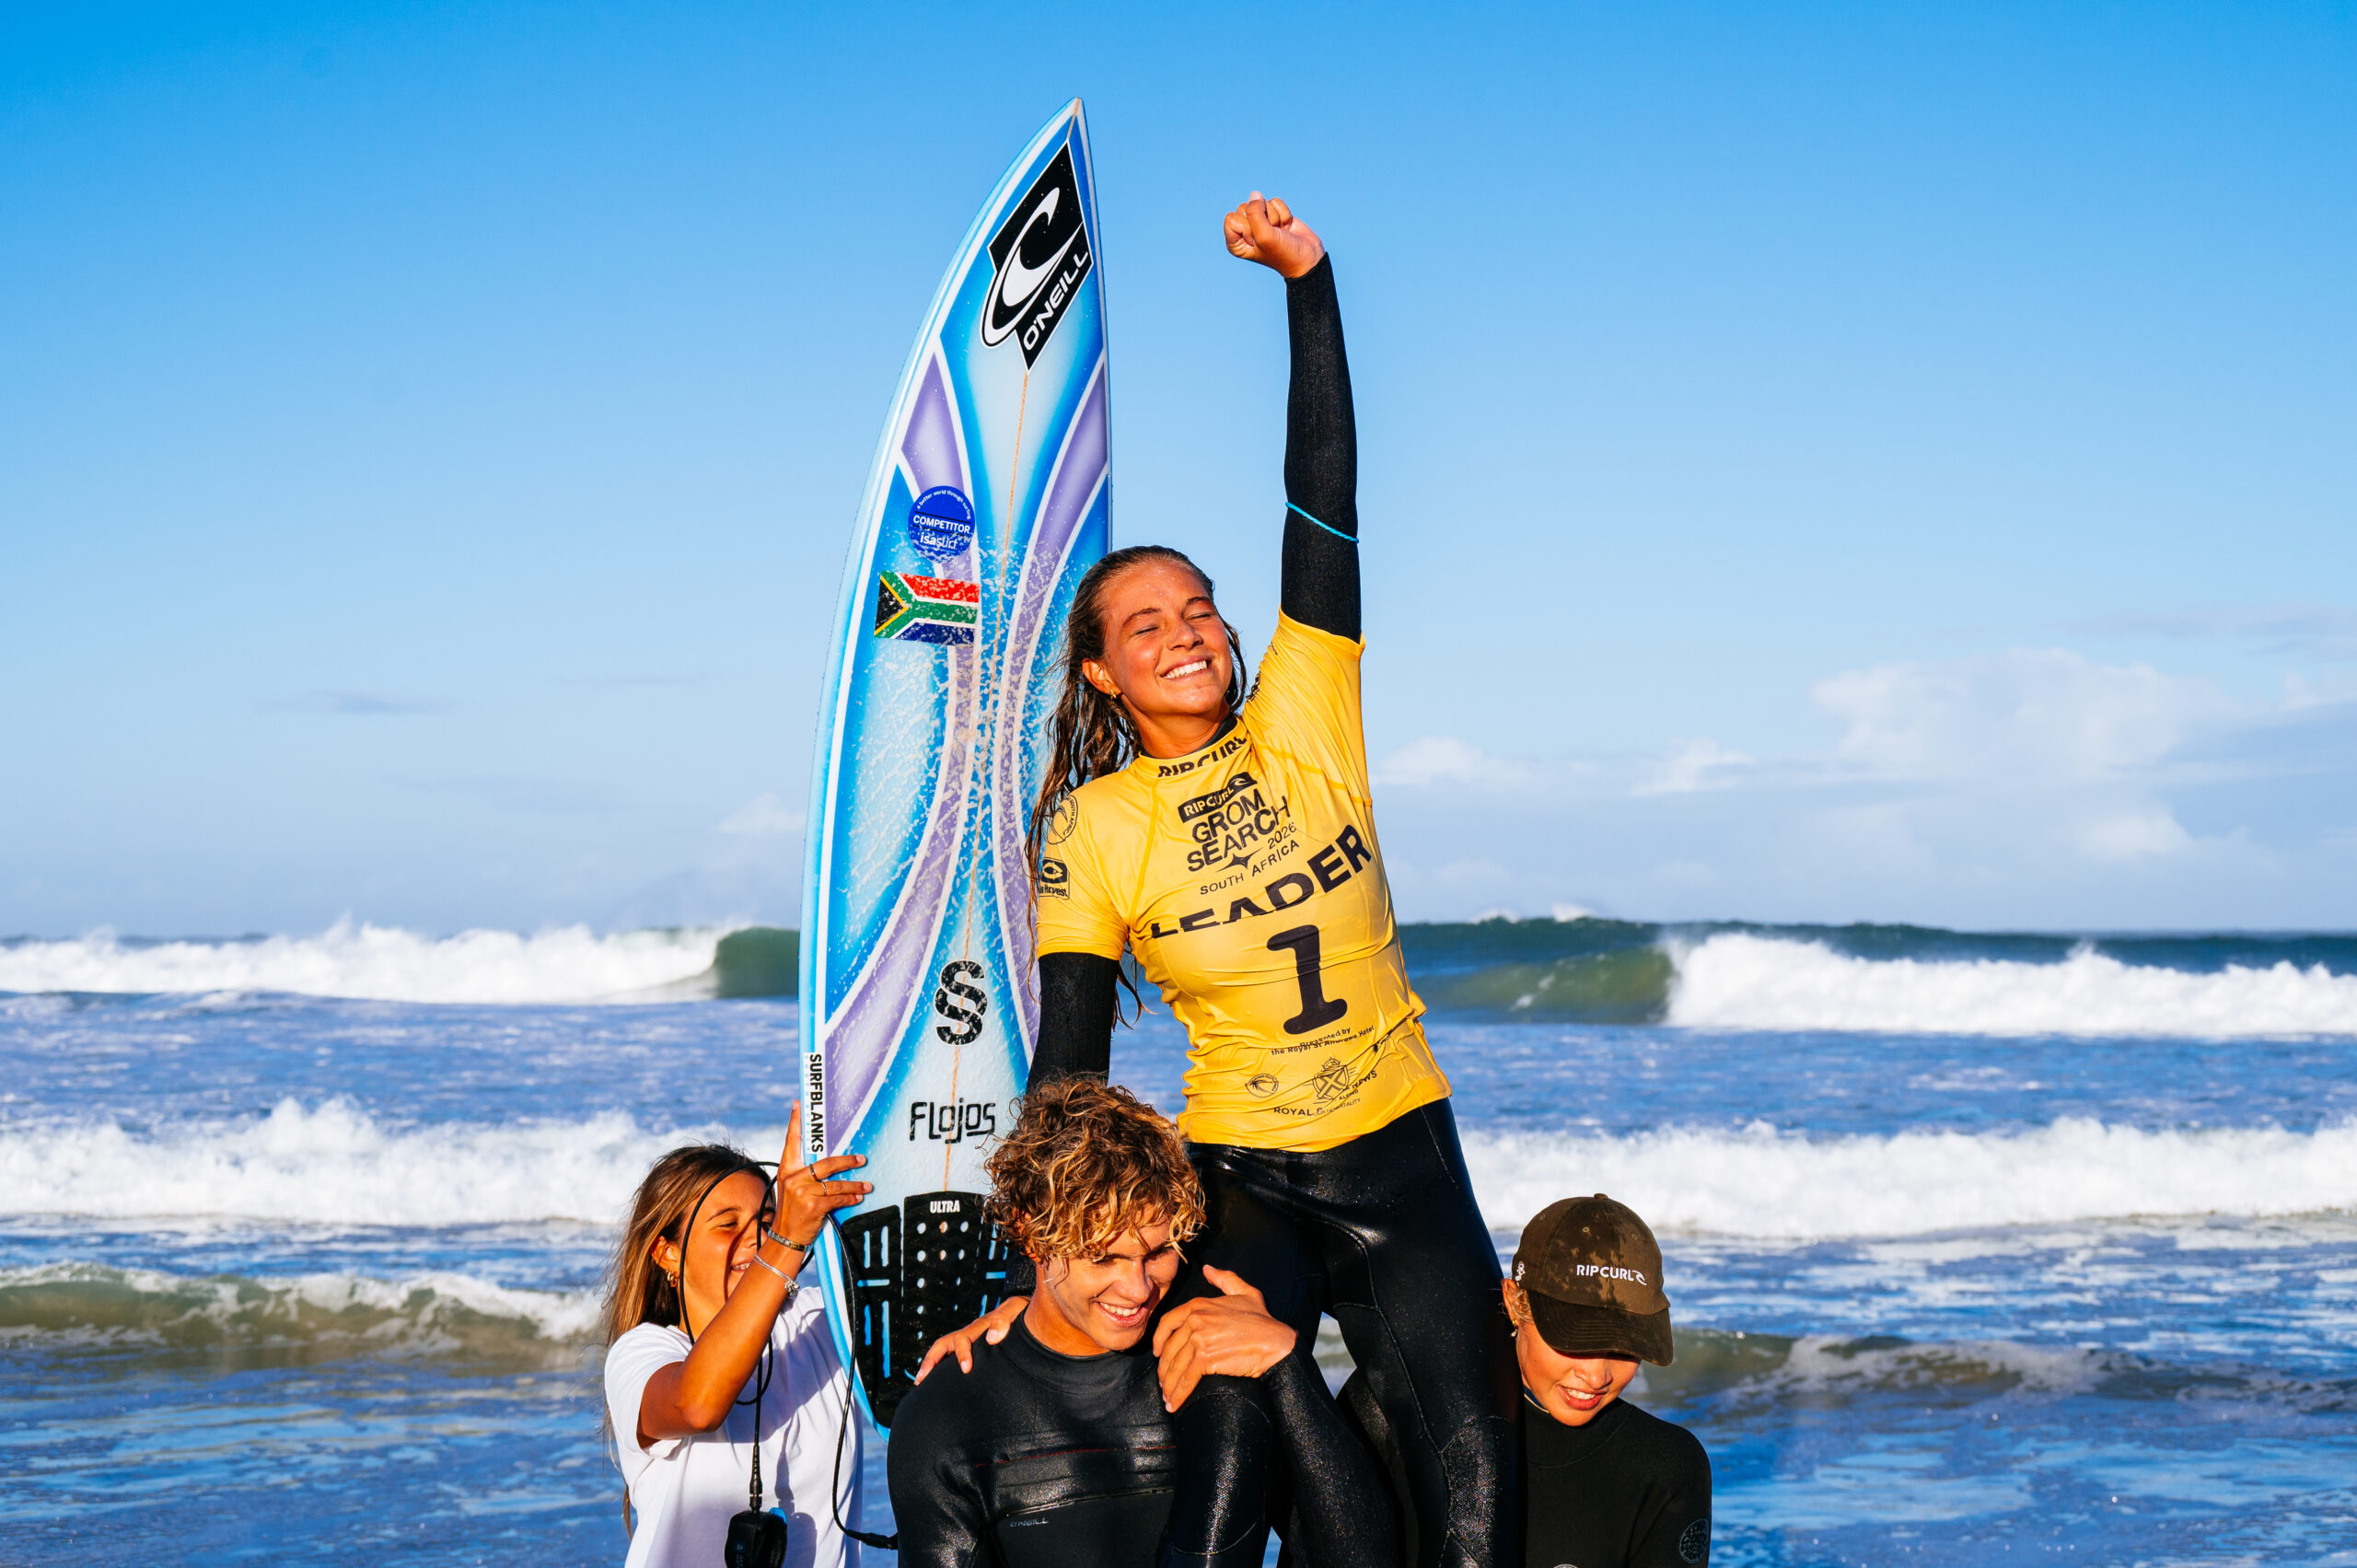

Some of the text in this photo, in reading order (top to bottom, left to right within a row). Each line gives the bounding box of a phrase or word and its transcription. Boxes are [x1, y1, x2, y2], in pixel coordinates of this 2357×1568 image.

[1023, 250, 1089, 351] O'NEILL
[913, 515, 970, 534] COMPETITOR
[1187, 796, 1291, 872] SEARCH
[1192, 788, 1266, 843] GROM
[1268, 821, 1297, 850] 2026
[1150, 824, 1372, 939] LEADER
[1200, 840, 1300, 895] SOUTH AFRICA
[1266, 924, 1348, 1035] 1
[1341, 1027, 1351, 1035] by
[809, 1053, 824, 1153] SURFBLANKS
[1274, 1107, 1313, 1116] ROYAL
[929, 1201, 960, 1214] ULTRA
